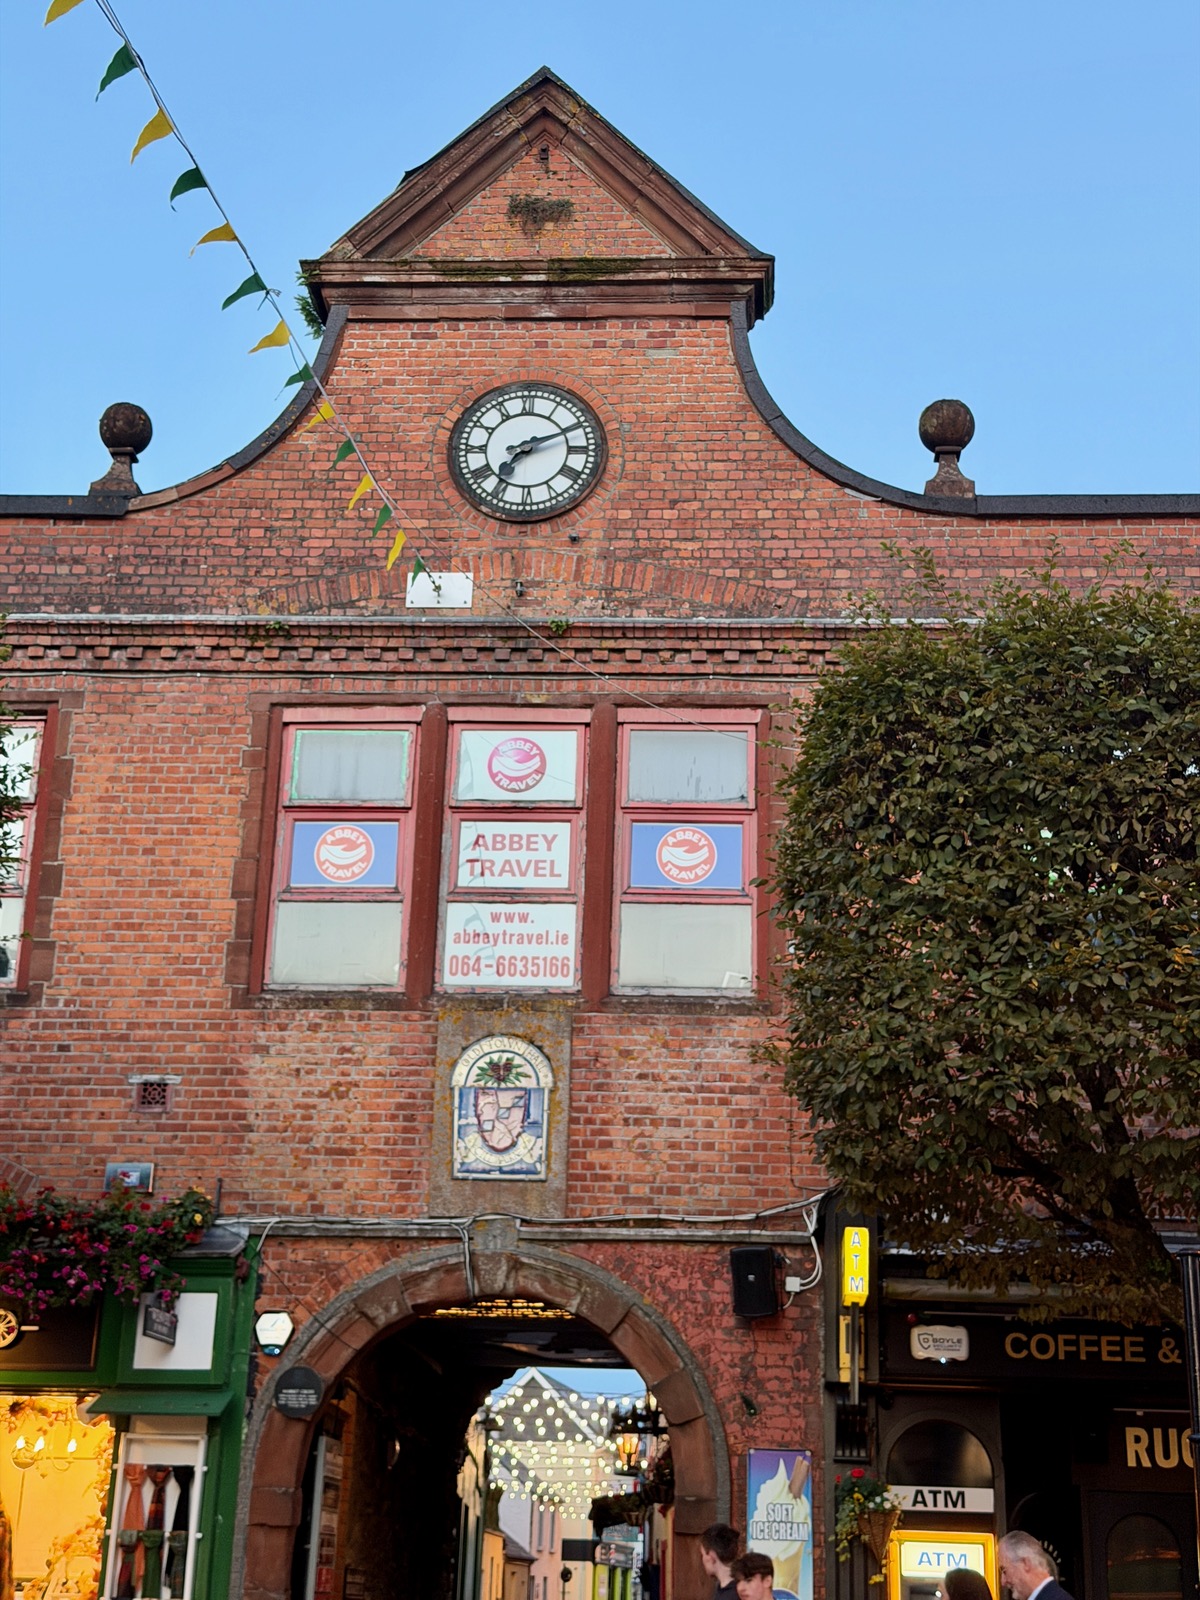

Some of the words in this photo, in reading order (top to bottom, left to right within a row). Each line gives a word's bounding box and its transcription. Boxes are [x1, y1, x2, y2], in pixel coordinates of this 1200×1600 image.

[494, 773, 543, 790] TRAVEL
[325, 828, 367, 844] ABBEY
[471, 833, 559, 852] ABBEY
[666, 830, 708, 846] ABBEY
[321, 861, 367, 878] TRAVEL
[465, 859, 562, 878] TRAVEL
[664, 862, 710, 880] TRAVEL
[490, 912, 535, 923] www.
[453, 928, 569, 947] abbeytravel.ie
[449, 954, 571, 978] 064-6635166
[850, 1231, 864, 1293] ATM
[1004, 1332, 1146, 1362] COFFEE
[1158, 1337, 1182, 1364] &
[911, 1489, 966, 1509] ATM
[767, 1503, 794, 1522] SOFT
[752, 1521, 770, 1540] ICE
[771, 1521, 809, 1541] CREAM
[917, 1551, 968, 1568] ATM
